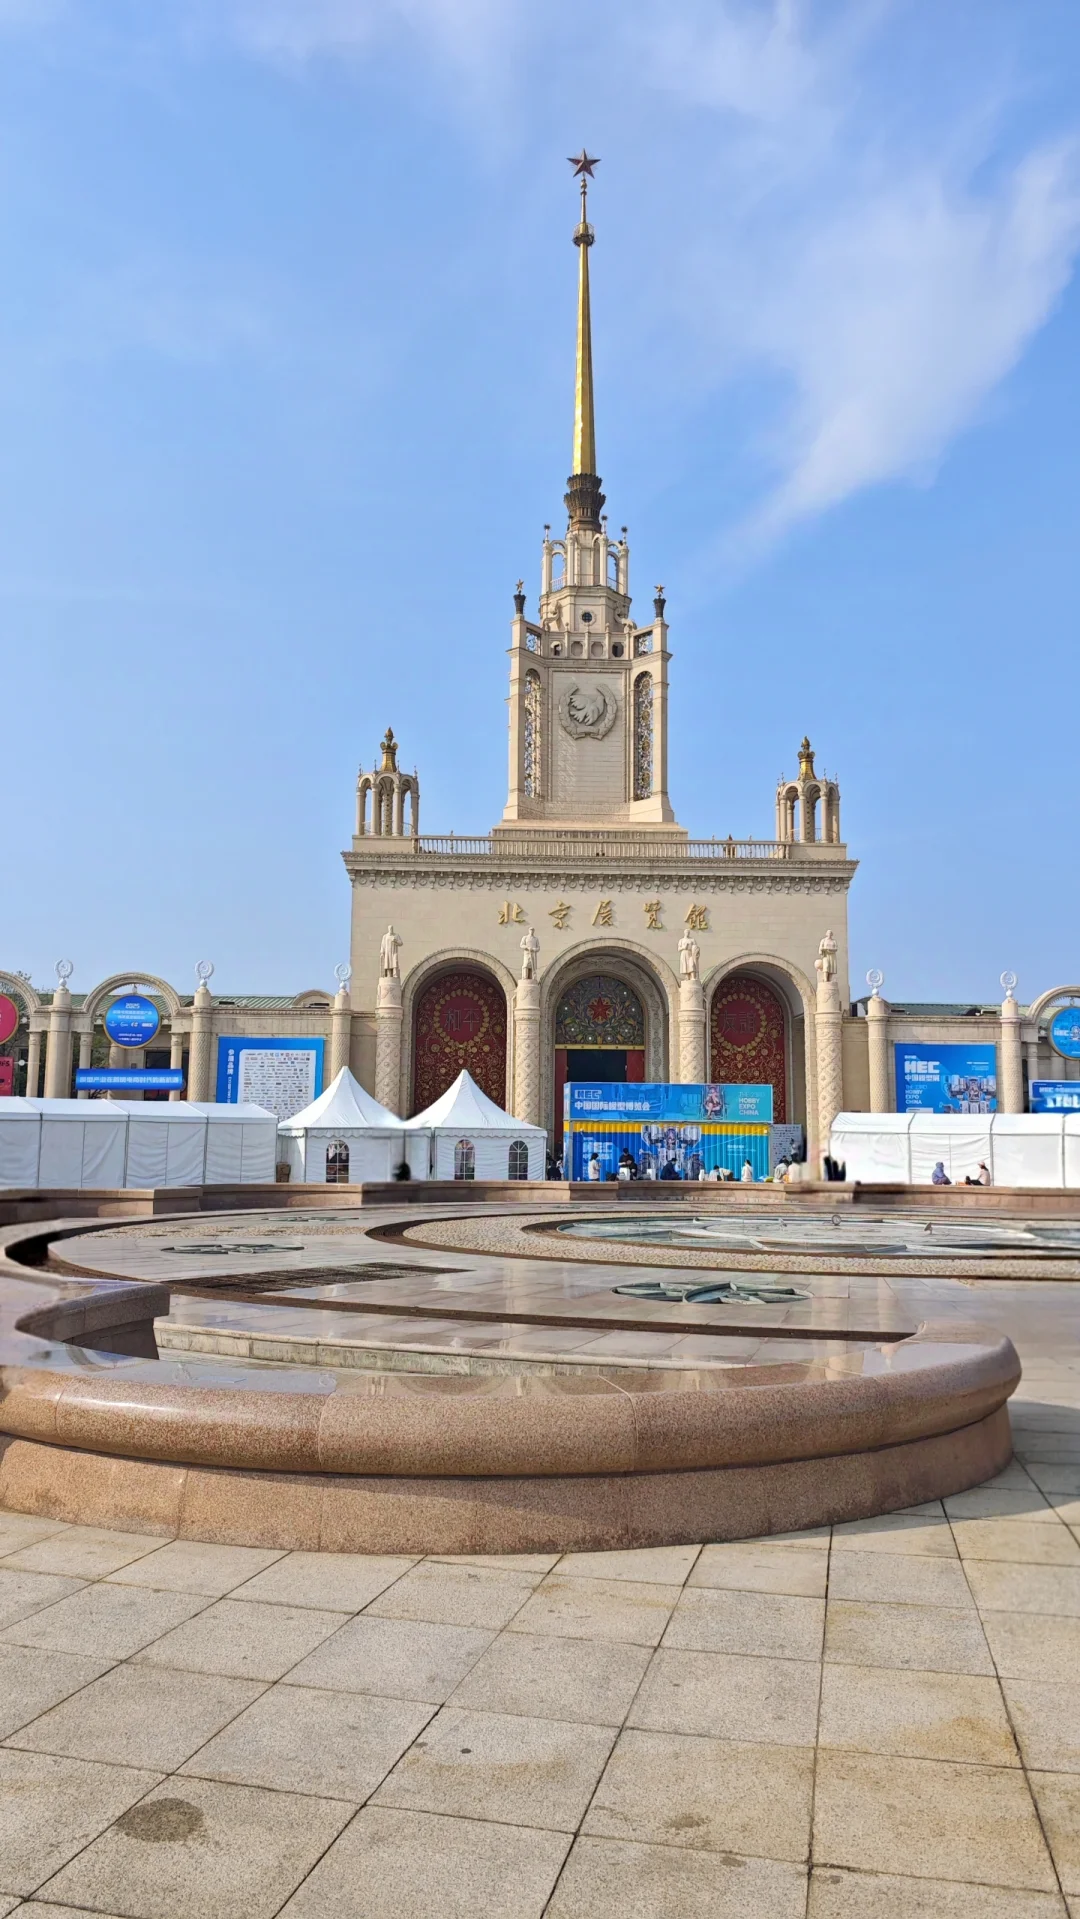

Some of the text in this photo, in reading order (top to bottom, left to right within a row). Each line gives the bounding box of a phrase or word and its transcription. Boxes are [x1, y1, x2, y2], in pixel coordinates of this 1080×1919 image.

[442, 1008, 480, 1032] 和平
[904, 1061, 940, 1074] HEC
[575, 1090, 602, 1100] HEC
[574, 1101, 650, 1111] 中国国际模型博览会
